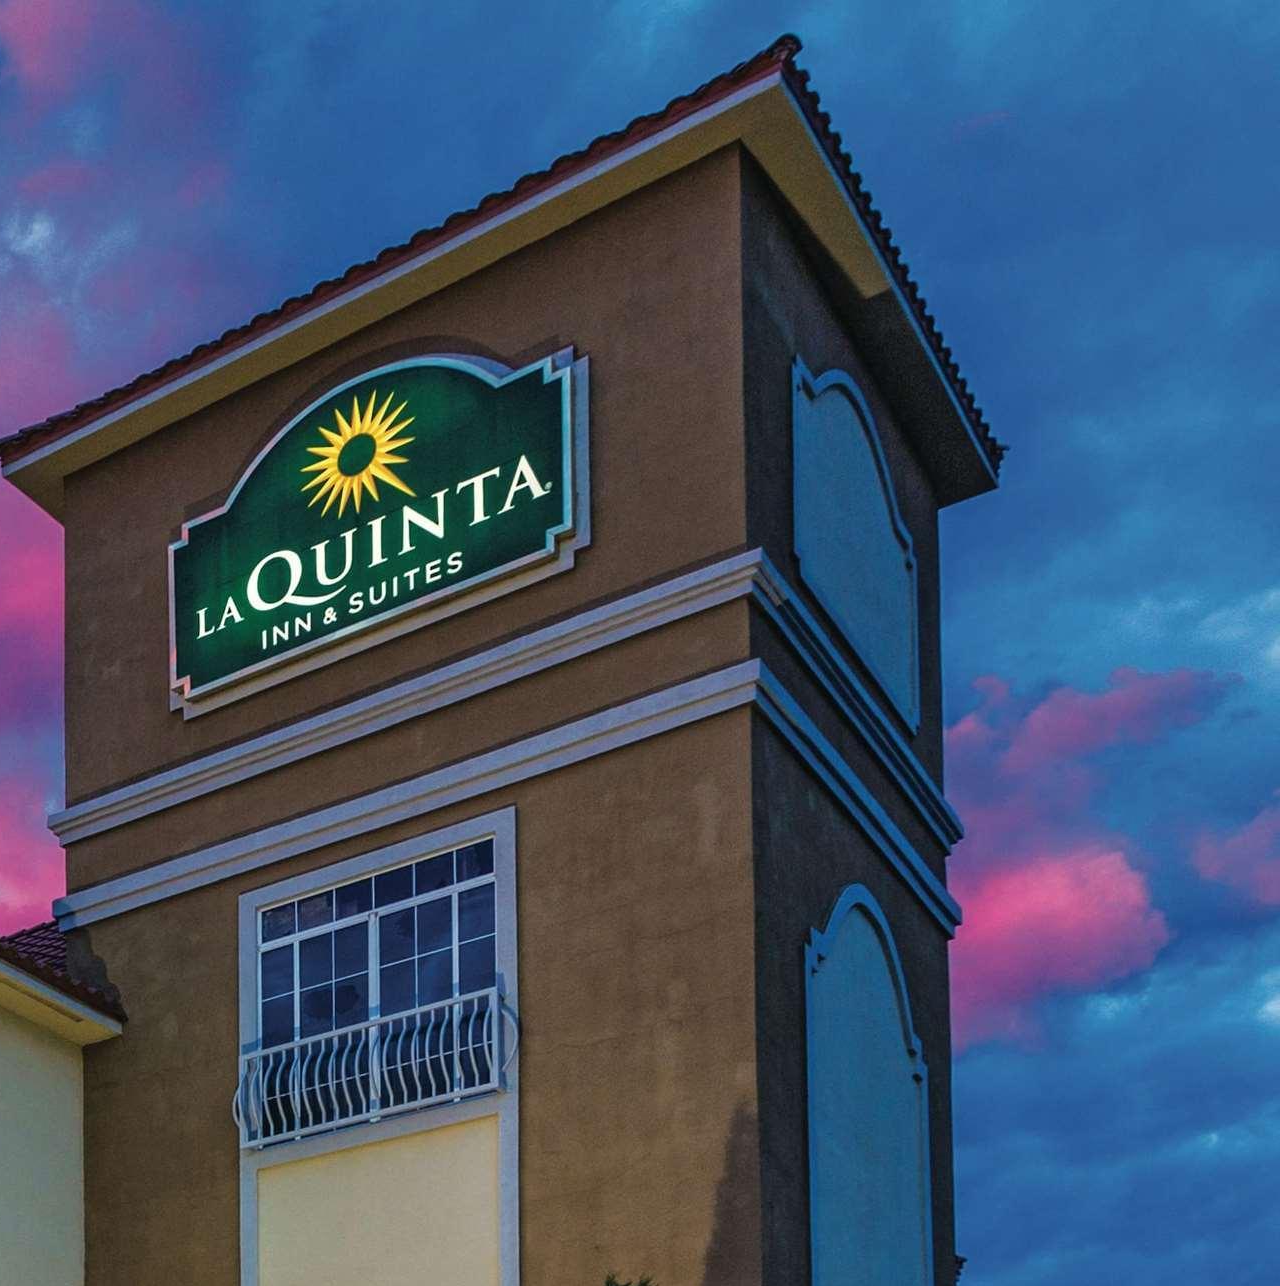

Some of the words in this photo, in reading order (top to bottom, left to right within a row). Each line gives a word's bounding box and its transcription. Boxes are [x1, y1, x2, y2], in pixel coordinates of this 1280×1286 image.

[196, 606, 244, 639] LA
[246, 455, 550, 611] QUINTA
[261, 612, 312, 650] INN
[323, 607, 338, 625] &
[348, 551, 463, 615] SUITES
